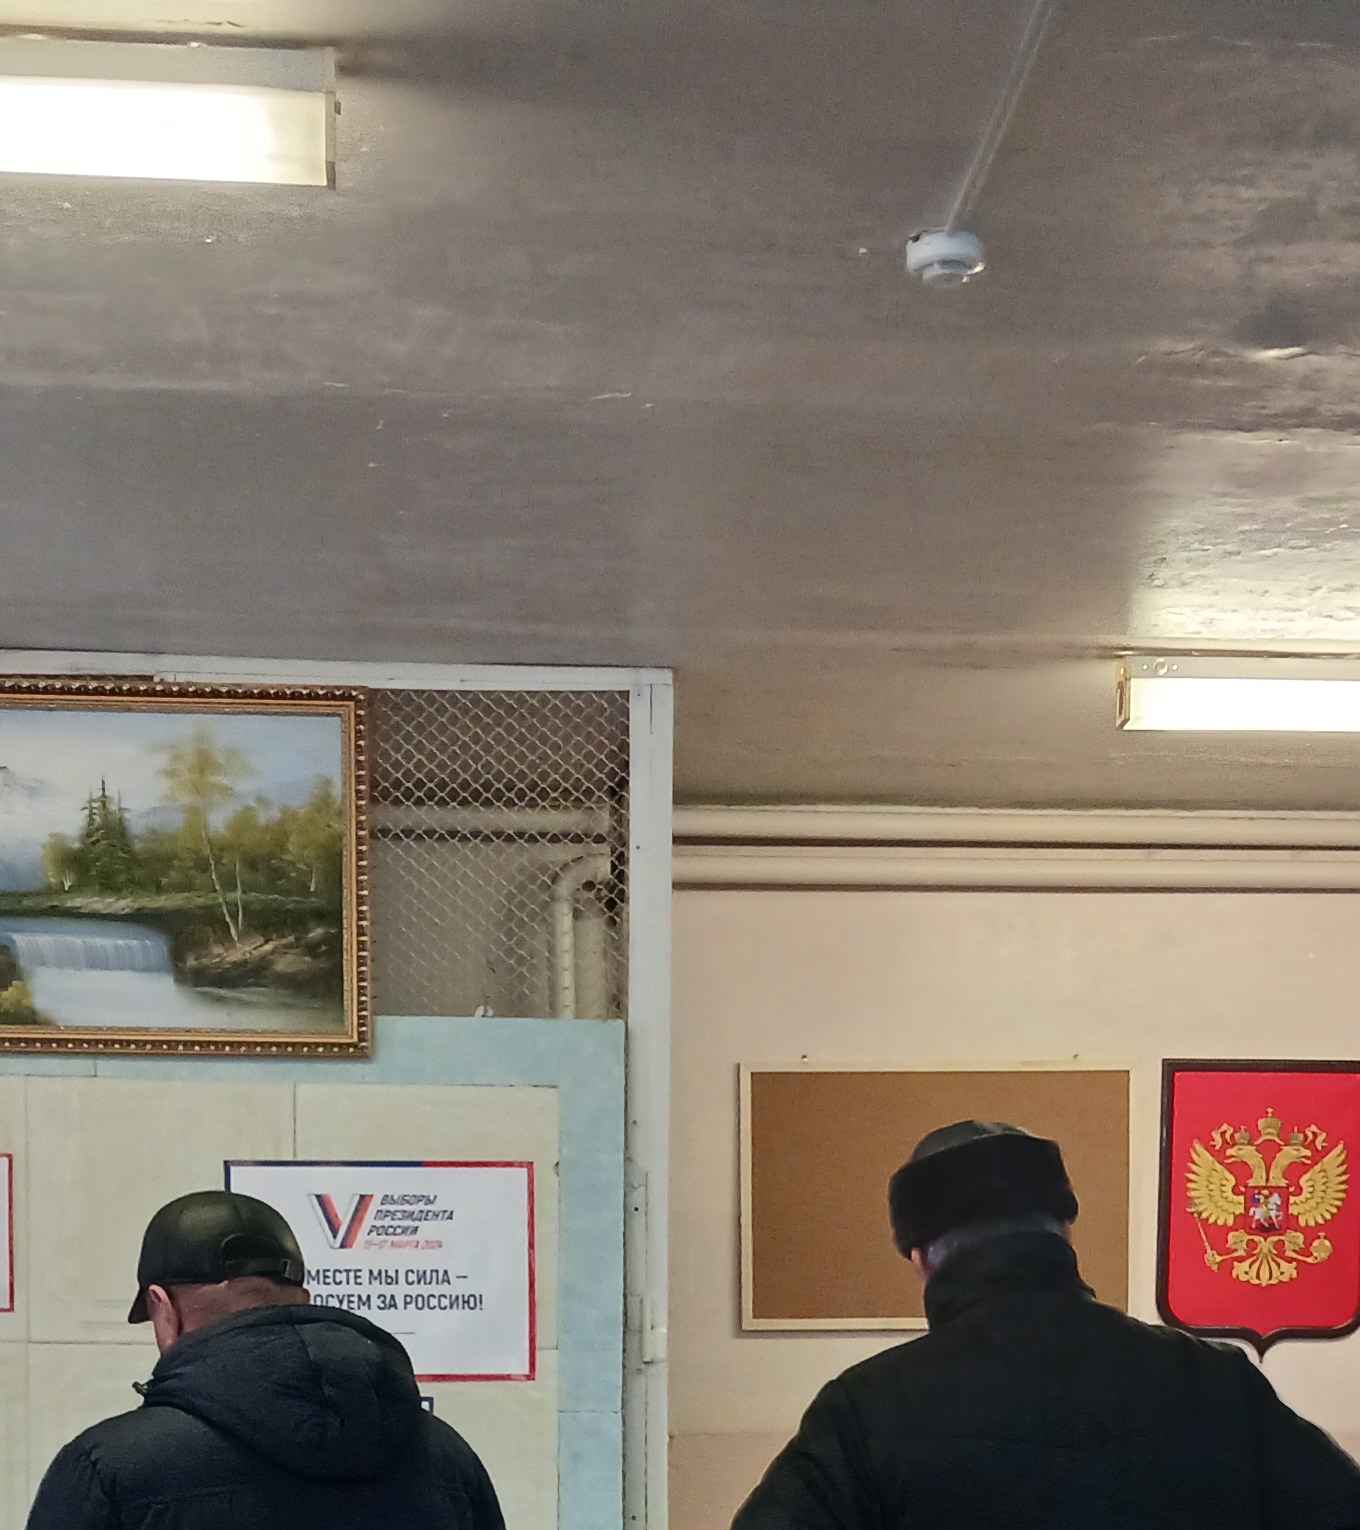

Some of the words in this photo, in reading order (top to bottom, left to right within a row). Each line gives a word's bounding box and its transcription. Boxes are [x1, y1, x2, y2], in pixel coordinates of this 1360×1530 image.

[380, 1194, 438, 1206] ВЫБОРЫ
[373, 1209, 454, 1222] ПРЕЗИДЕНТА
[367, 1225, 420, 1236] РОССИИ
[306, 1269, 363, 1286] МЕСТЕ
[368, 1269, 399, 1286] МЫ
[404, 1269, 452, 1286] СИЛА
[313, 1293, 372, 1311] ОСУЕМ
[376, 1293, 399, 1311] ЗА
[403, 1293, 484, 1311] РОССИЮ!
